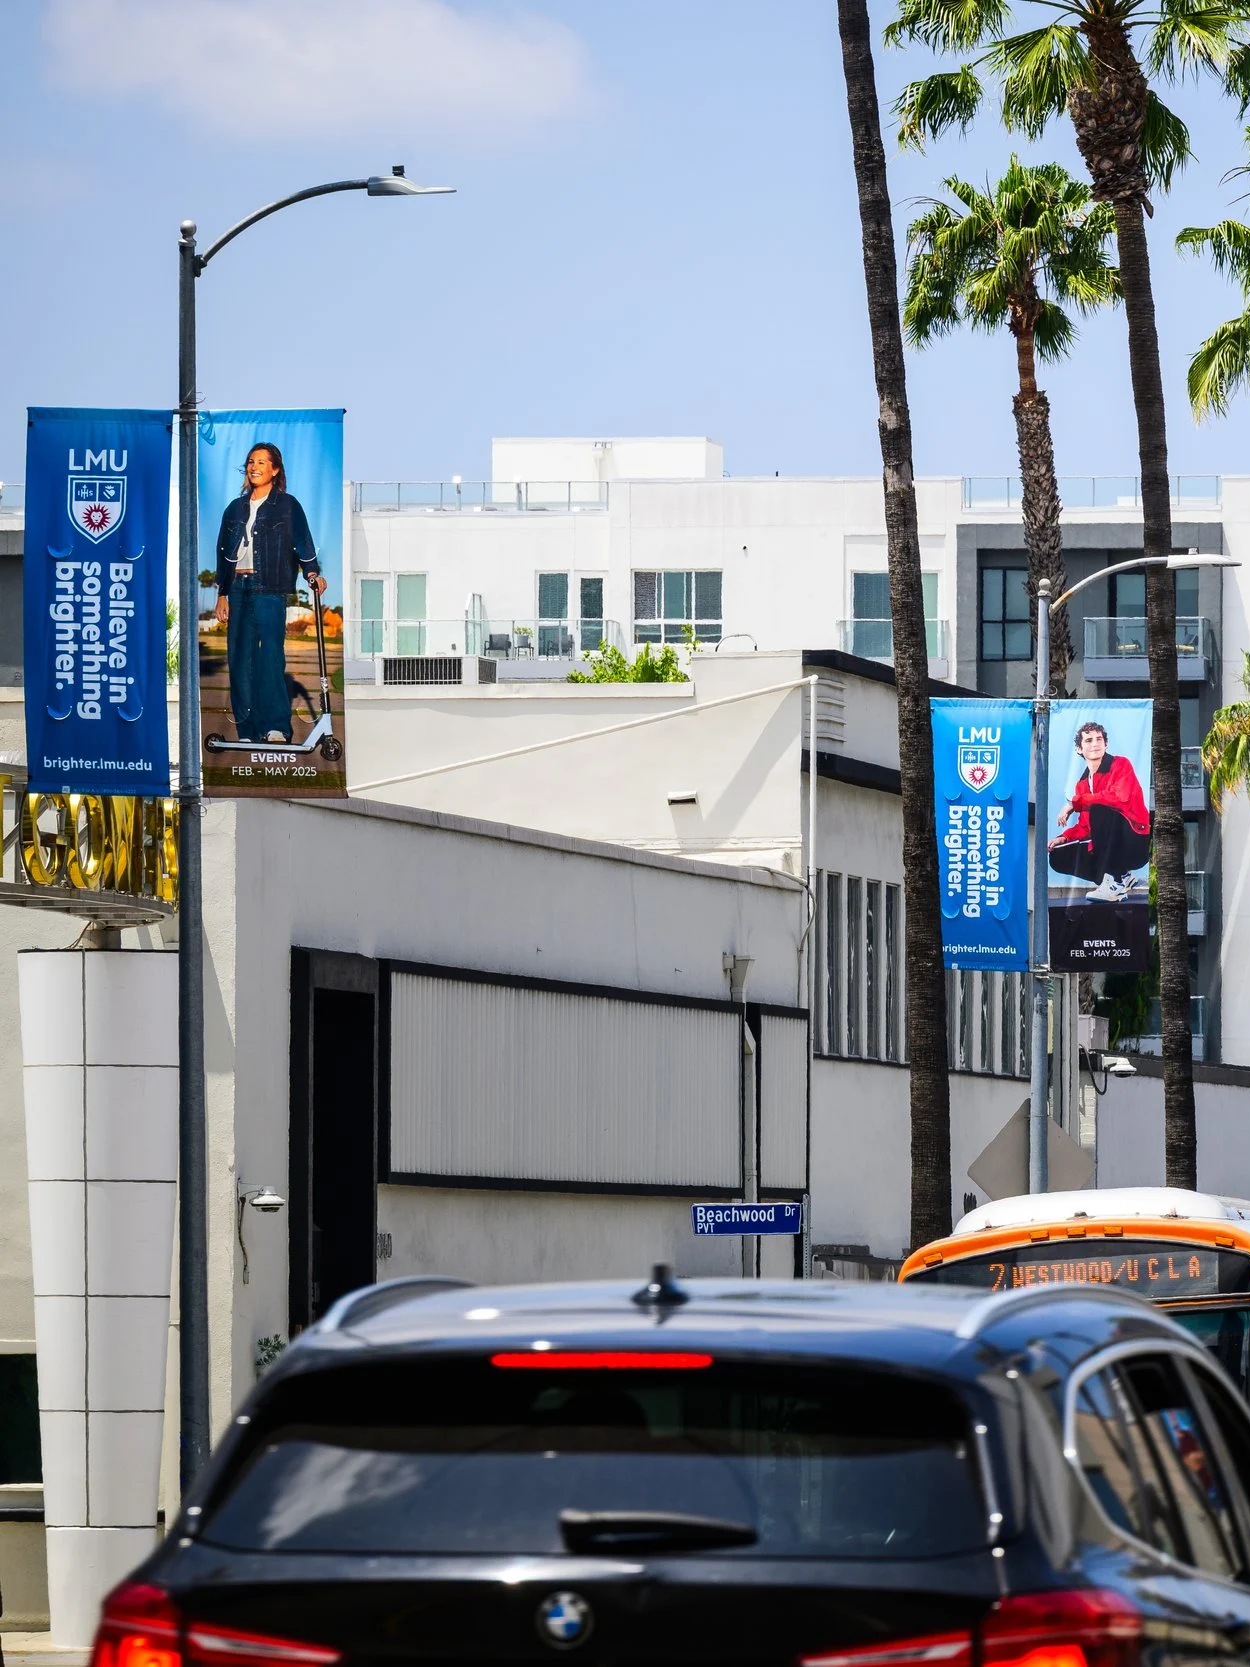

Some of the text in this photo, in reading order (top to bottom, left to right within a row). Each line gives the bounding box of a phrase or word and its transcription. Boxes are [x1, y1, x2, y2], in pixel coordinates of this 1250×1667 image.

[69, 449, 128, 471] LMU
[49, 562, 82, 690] brighter.
[108, 563, 135, 704] Believe in
[77, 561, 108, 720] something
[958, 726, 1001, 743] LMU
[43, 756, 153, 771] brighter.lmu.edu
[250, 753, 297, 763] EVENTS
[232, 766, 255, 776] FEB.
[265, 767, 289, 776] MAY
[291, 767, 318, 776] 2025
[944, 805, 968, 897] brighter.
[985, 805, 1005, 906] Believe in
[963, 805, 986, 918] something
[1083, 940, 1116, 948] EVENTS
[1070, 949, 1087, 958] FEB.
[1112, 949, 1131, 957] 2025
[696, 1205, 796, 1222] Beachwood Dr
[697, 1223, 715, 1233] PVT
